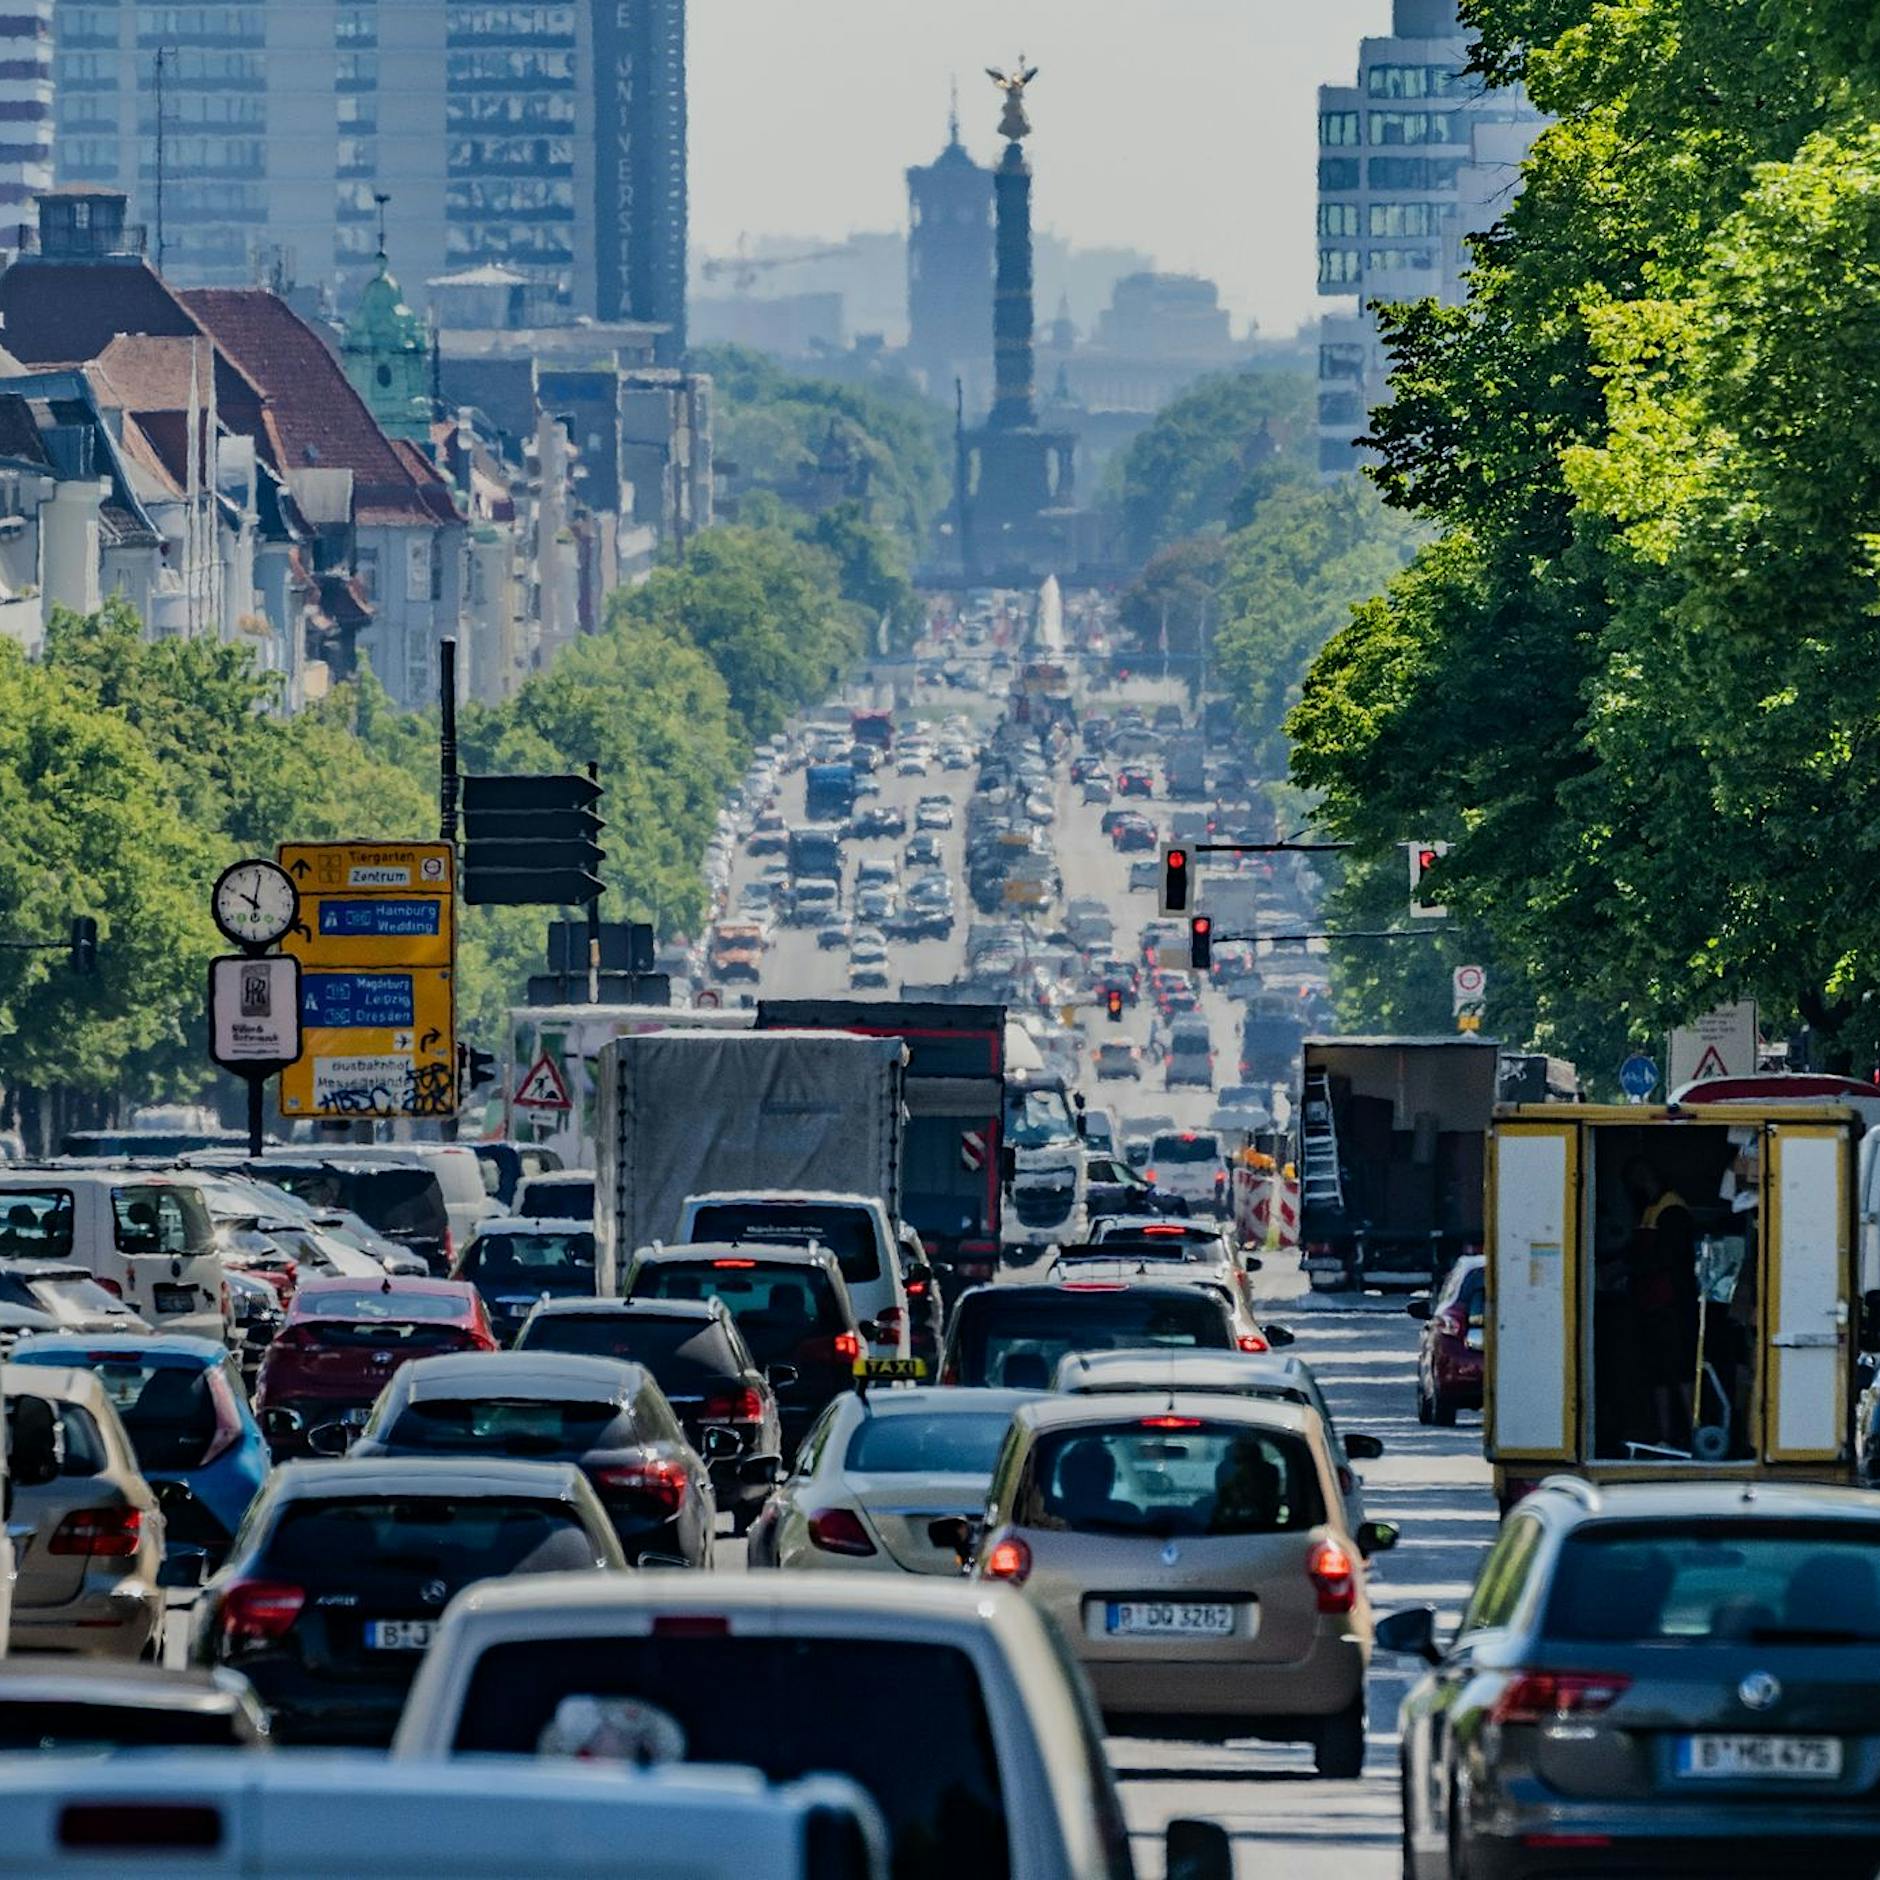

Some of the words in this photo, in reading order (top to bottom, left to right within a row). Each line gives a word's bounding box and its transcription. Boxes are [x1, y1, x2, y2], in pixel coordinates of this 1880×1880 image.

[348, 850, 416, 866] Tiergarten
[351, 869, 408, 883] Zentrum
[375, 904, 437, 920] Hamburg
[376, 920, 434, 934] Wedding
[356, 977, 410, 991] Magdeburg
[364, 993, 411, 1008] Leipzig
[355, 1009, 411, 1022] Dresden
[869, 1361, 915, 1374] TAXI
